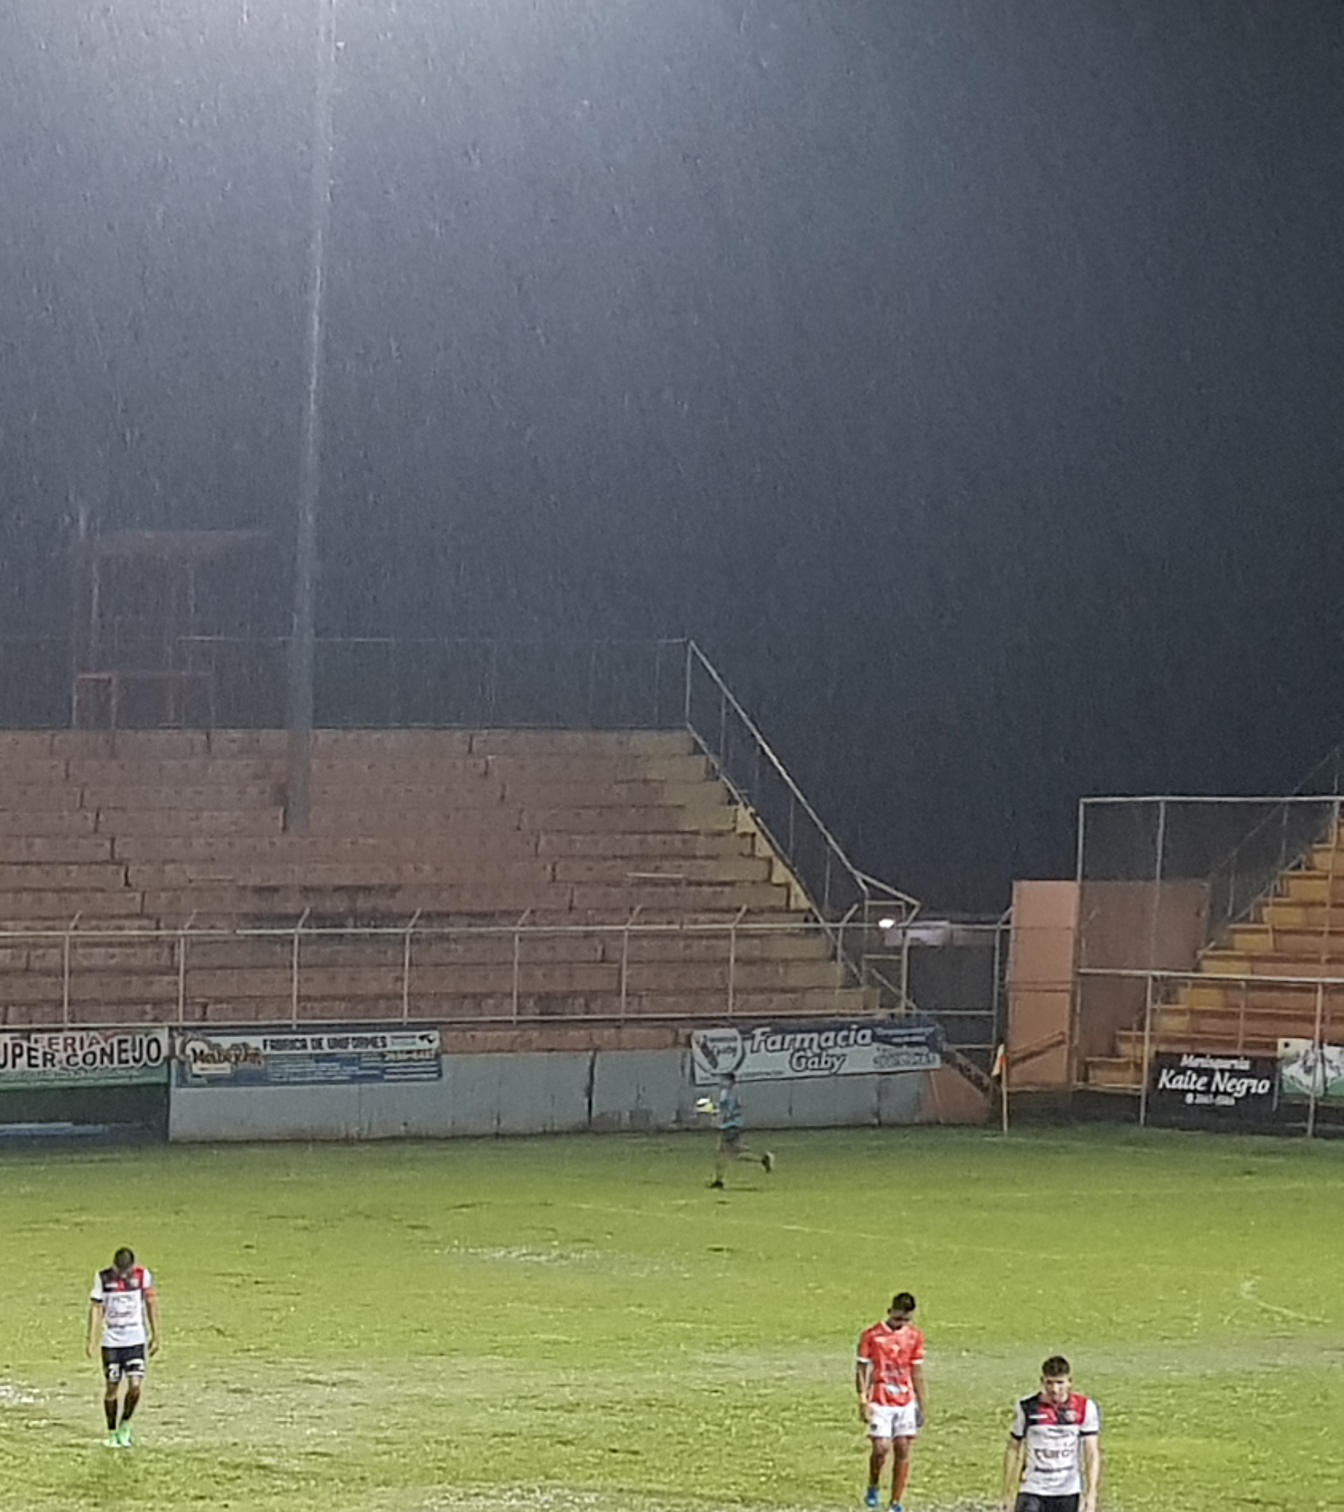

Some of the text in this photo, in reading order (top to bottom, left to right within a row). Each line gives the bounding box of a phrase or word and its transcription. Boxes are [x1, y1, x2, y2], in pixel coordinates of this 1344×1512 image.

[33, 1033, 104, 1054] FERIA
[65, 1036, 163, 1067] CONEJO
[310, 1037, 324, 1050] DE
[751, 1025, 874, 1053] Farmacia
[789, 1050, 846, 1075] Gaby
[1211, 1071, 1270, 1098] Negro
